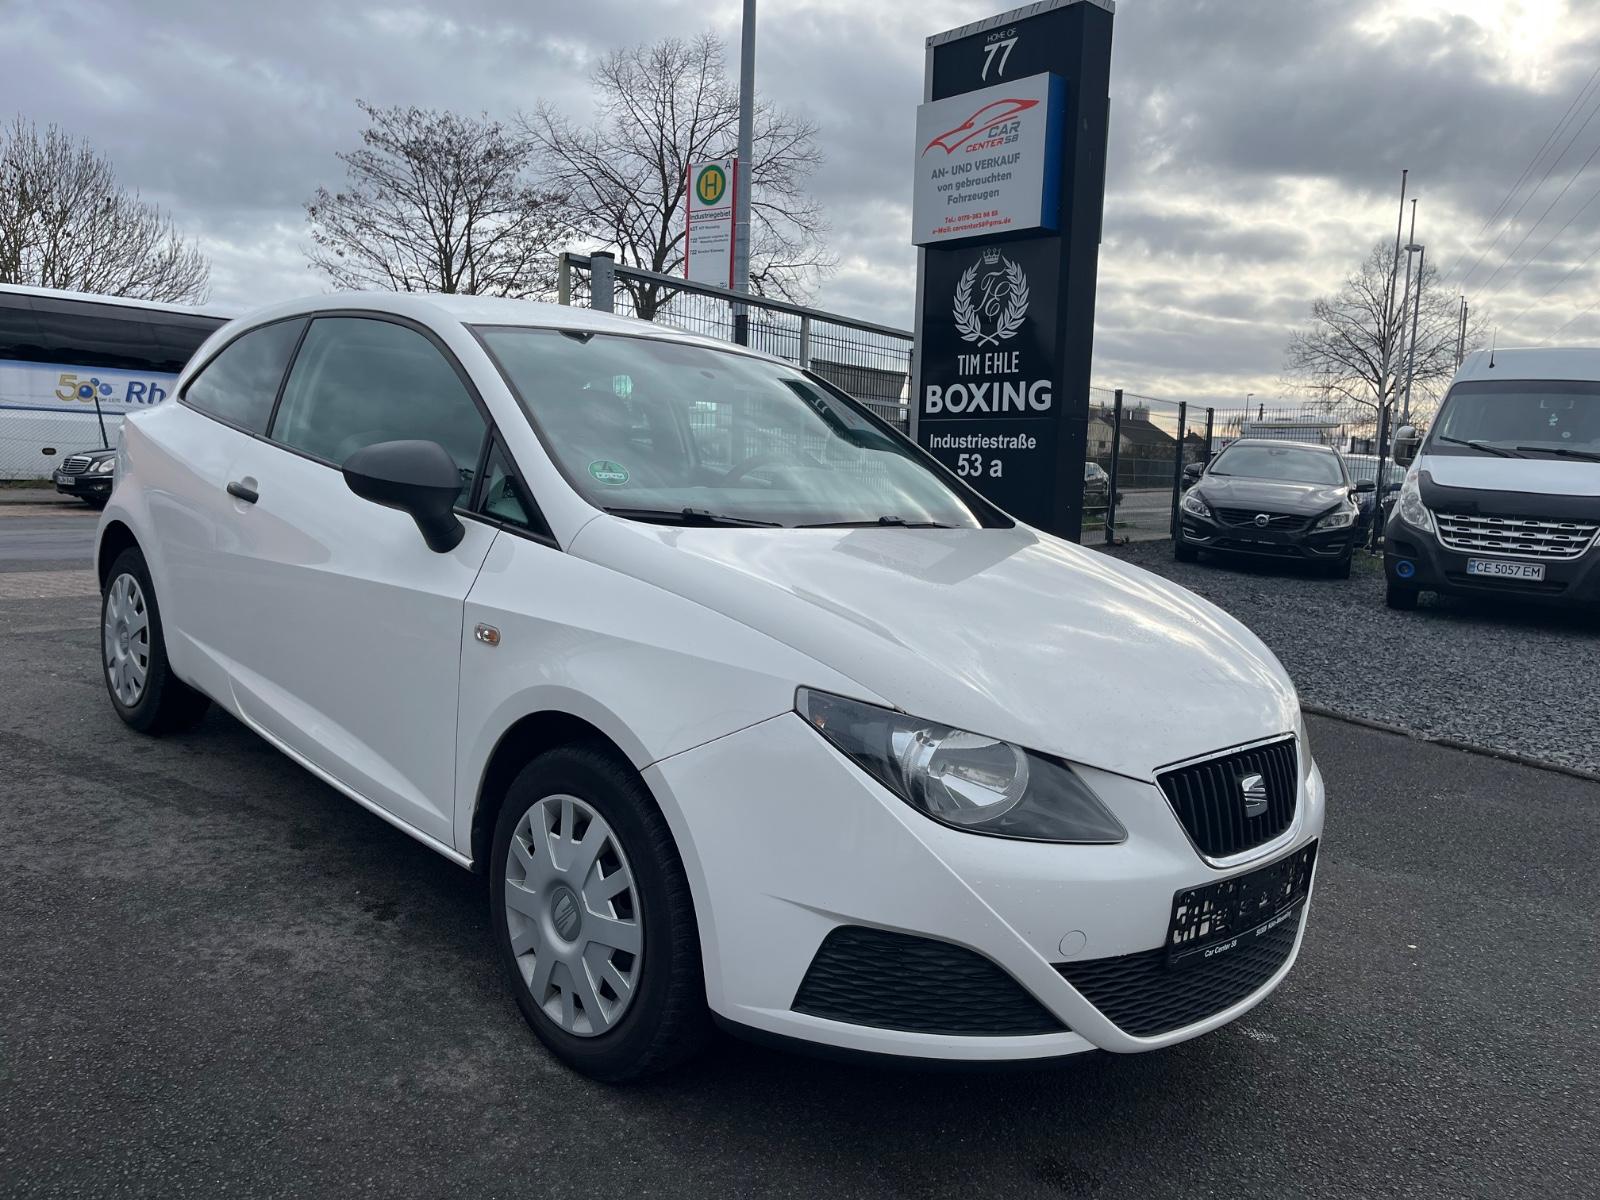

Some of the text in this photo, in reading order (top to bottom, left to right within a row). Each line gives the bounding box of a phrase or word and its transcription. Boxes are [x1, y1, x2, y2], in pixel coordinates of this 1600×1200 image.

[981, 37, 1019, 82] 77
[987, 121, 1021, 139] CAR
[931, 152, 1021, 180] AN- UND VERKAUF
[704, 173, 718, 198] H
[937, 171, 1012, 193] von gebrauchten
[947, 189, 1000, 206] Fahrzeugen
[957, 351, 1020, 375] TIM EHLE
[925, 380, 1052, 414] BOXING
[929, 433, 1037, 449] Industriestraße
[957, 453, 1003, 478] 53 a
[1476, 562, 1541, 578] CE 5057 EM
[1204, 949, 1214, 958] Car
[1214, 943, 1231, 954] Center
